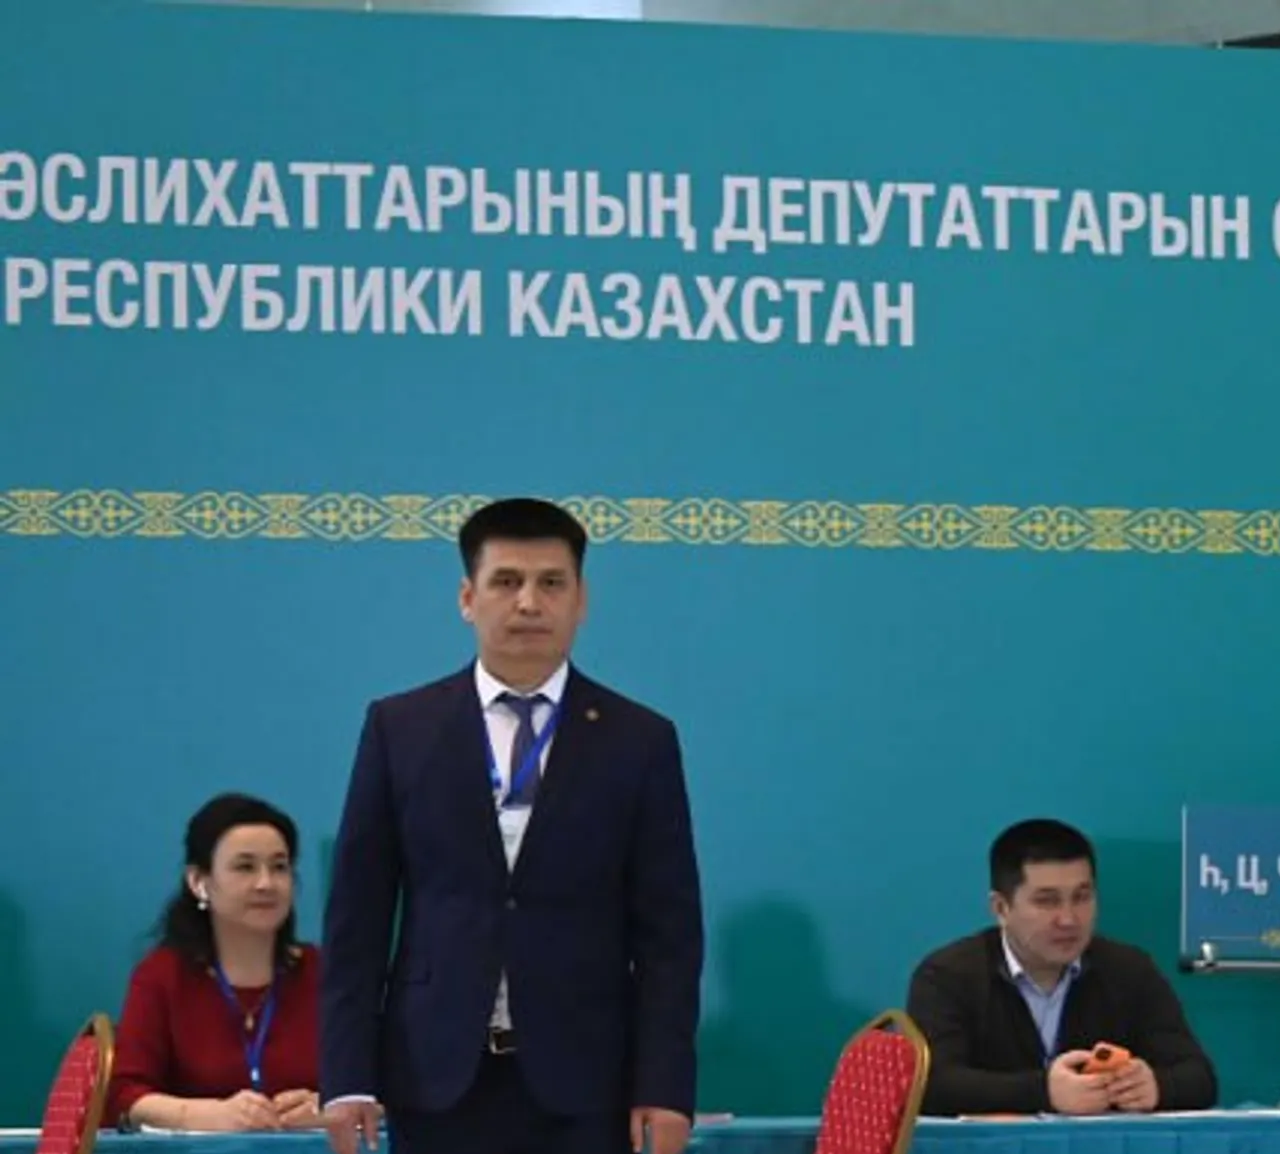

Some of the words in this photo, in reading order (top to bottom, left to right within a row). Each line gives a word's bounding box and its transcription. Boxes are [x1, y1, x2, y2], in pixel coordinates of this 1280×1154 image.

[712, 175, 1250, 260] ДЕПУТАТТАРЫН
[5, 257, 483, 336] РЕСПУБЛИКИ
[508, 270, 915, 347] КАЗАХСТАН
[1236, 854, 1269, 895] Ц,
